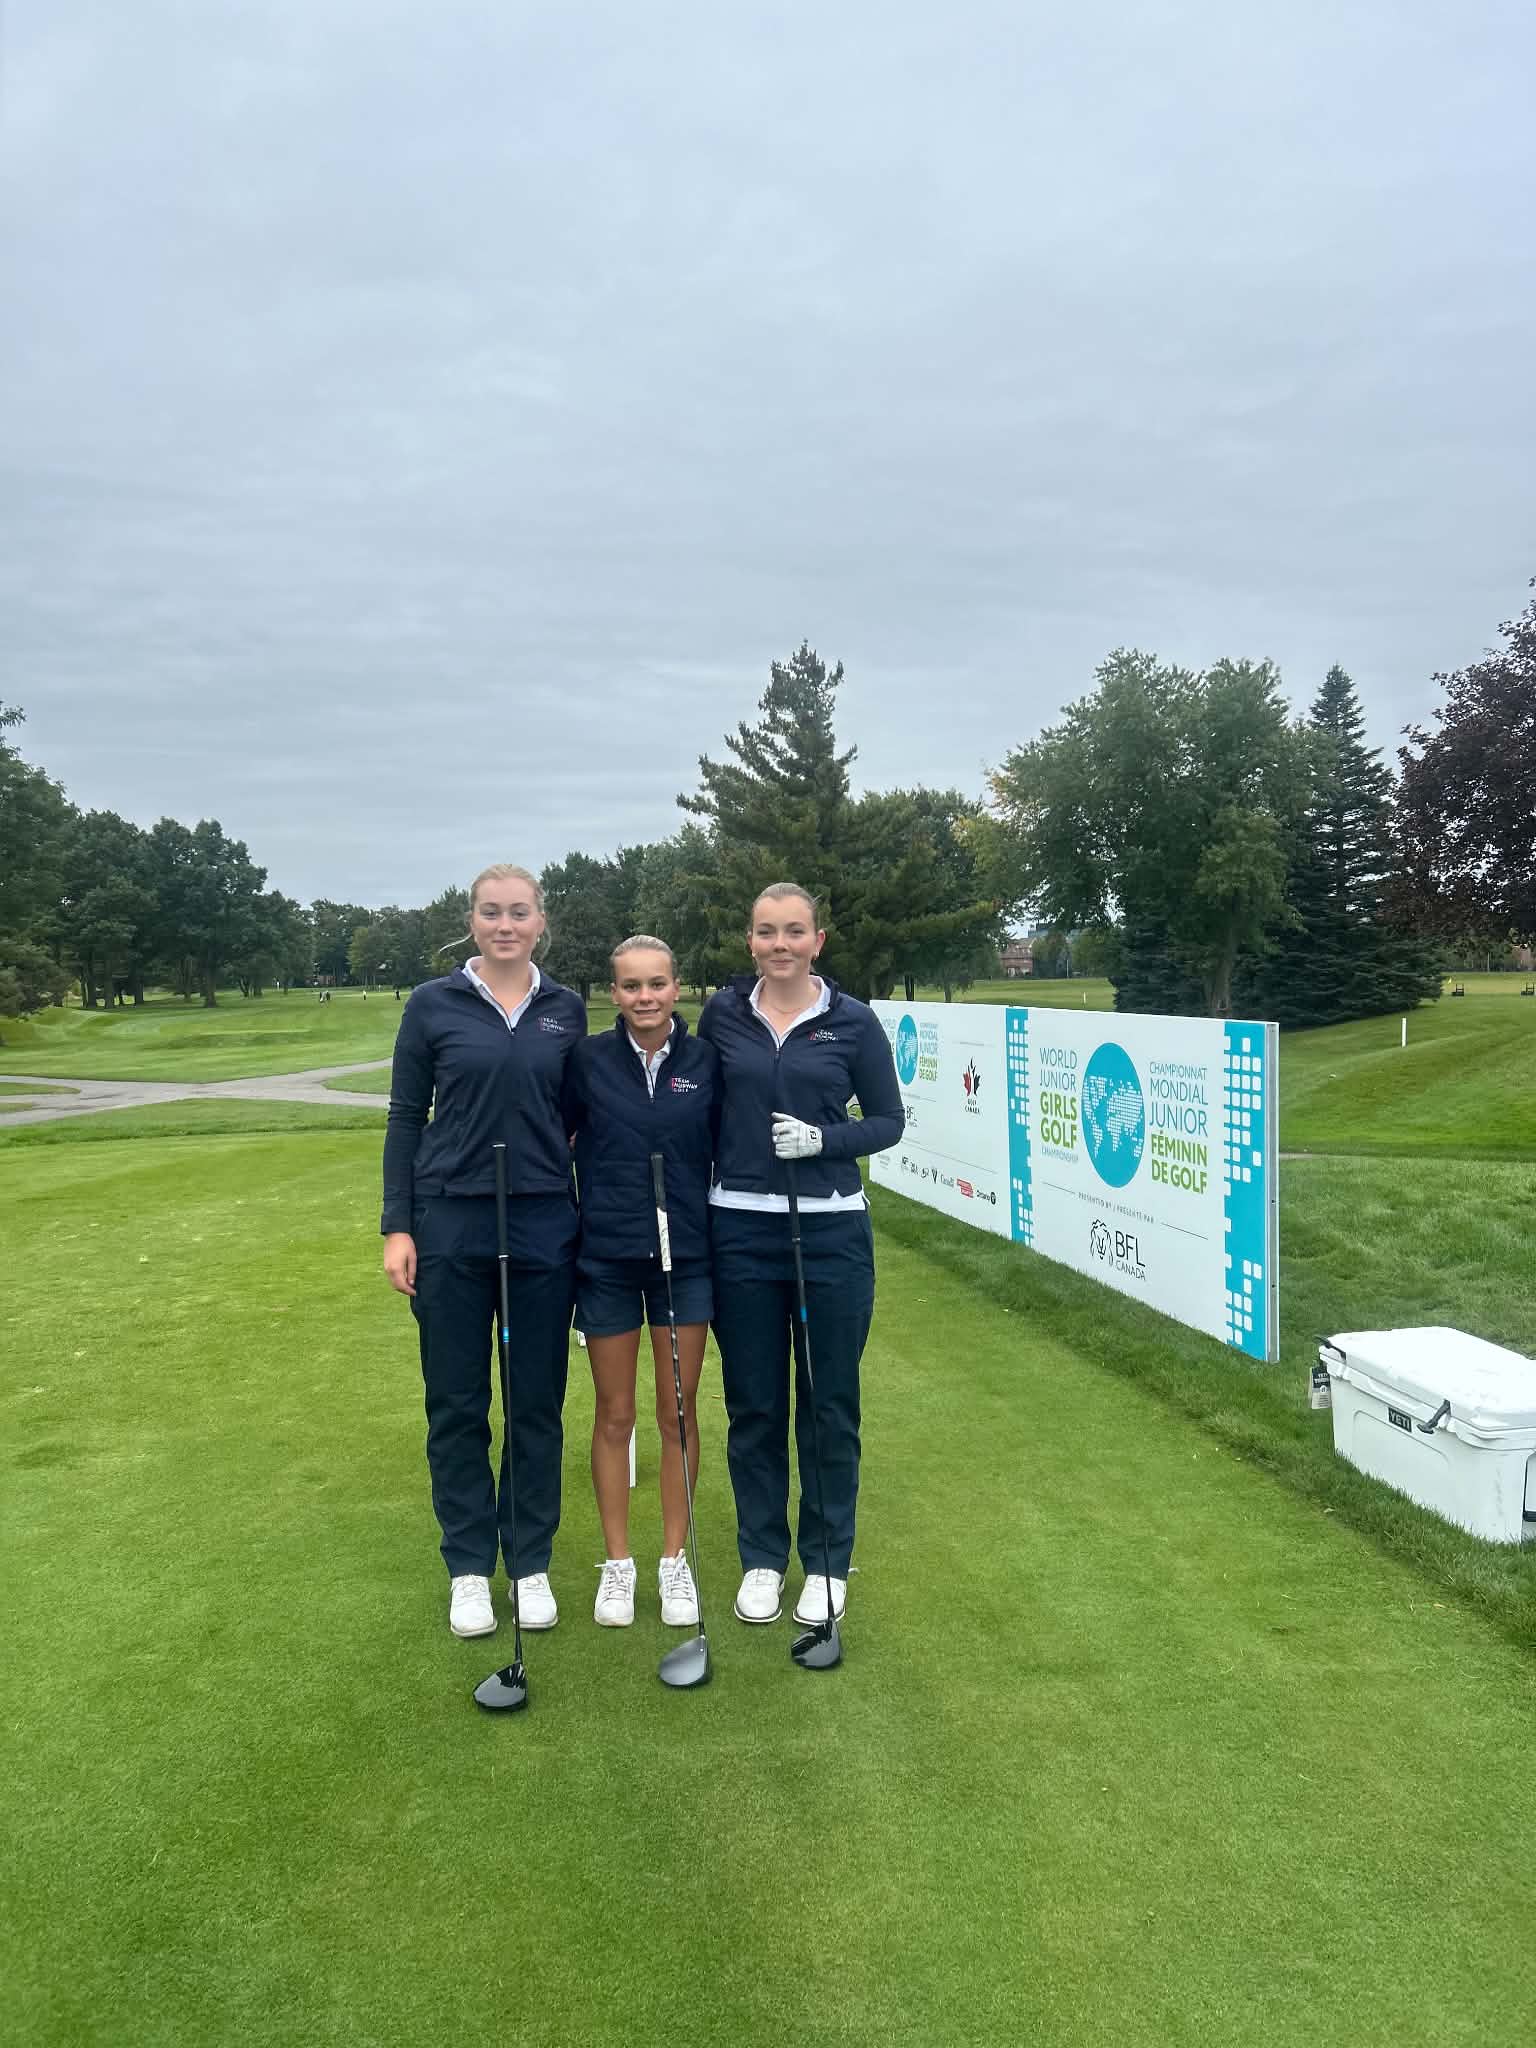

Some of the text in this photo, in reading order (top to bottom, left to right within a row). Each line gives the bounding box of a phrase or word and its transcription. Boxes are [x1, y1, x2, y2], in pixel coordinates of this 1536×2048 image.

[1039, 1047, 1078, 1070] WORLD
[1149, 1061, 1208, 1081] CHAMPIONNAT
[1039, 1069, 1077, 1093] JUNIOR
[1149, 1077, 1209, 1106] MONDIAL
[1039, 1091, 1078, 1122] GIRLS
[1149, 1101, 1209, 1138] JUNIOR
[1040, 1117, 1078, 1150] GOLF
[1041, 1146, 1079, 1164] CHAMPIONSHIP
[1150, 1130, 1208, 1168] FÉMININ
[1150, 1159, 1208, 1195] DE GOLF
[1115, 1230, 1146, 1268] BFL
[1116, 1259, 1146, 1282] CANADA
[1389, 1409, 1410, 1431] YETI
